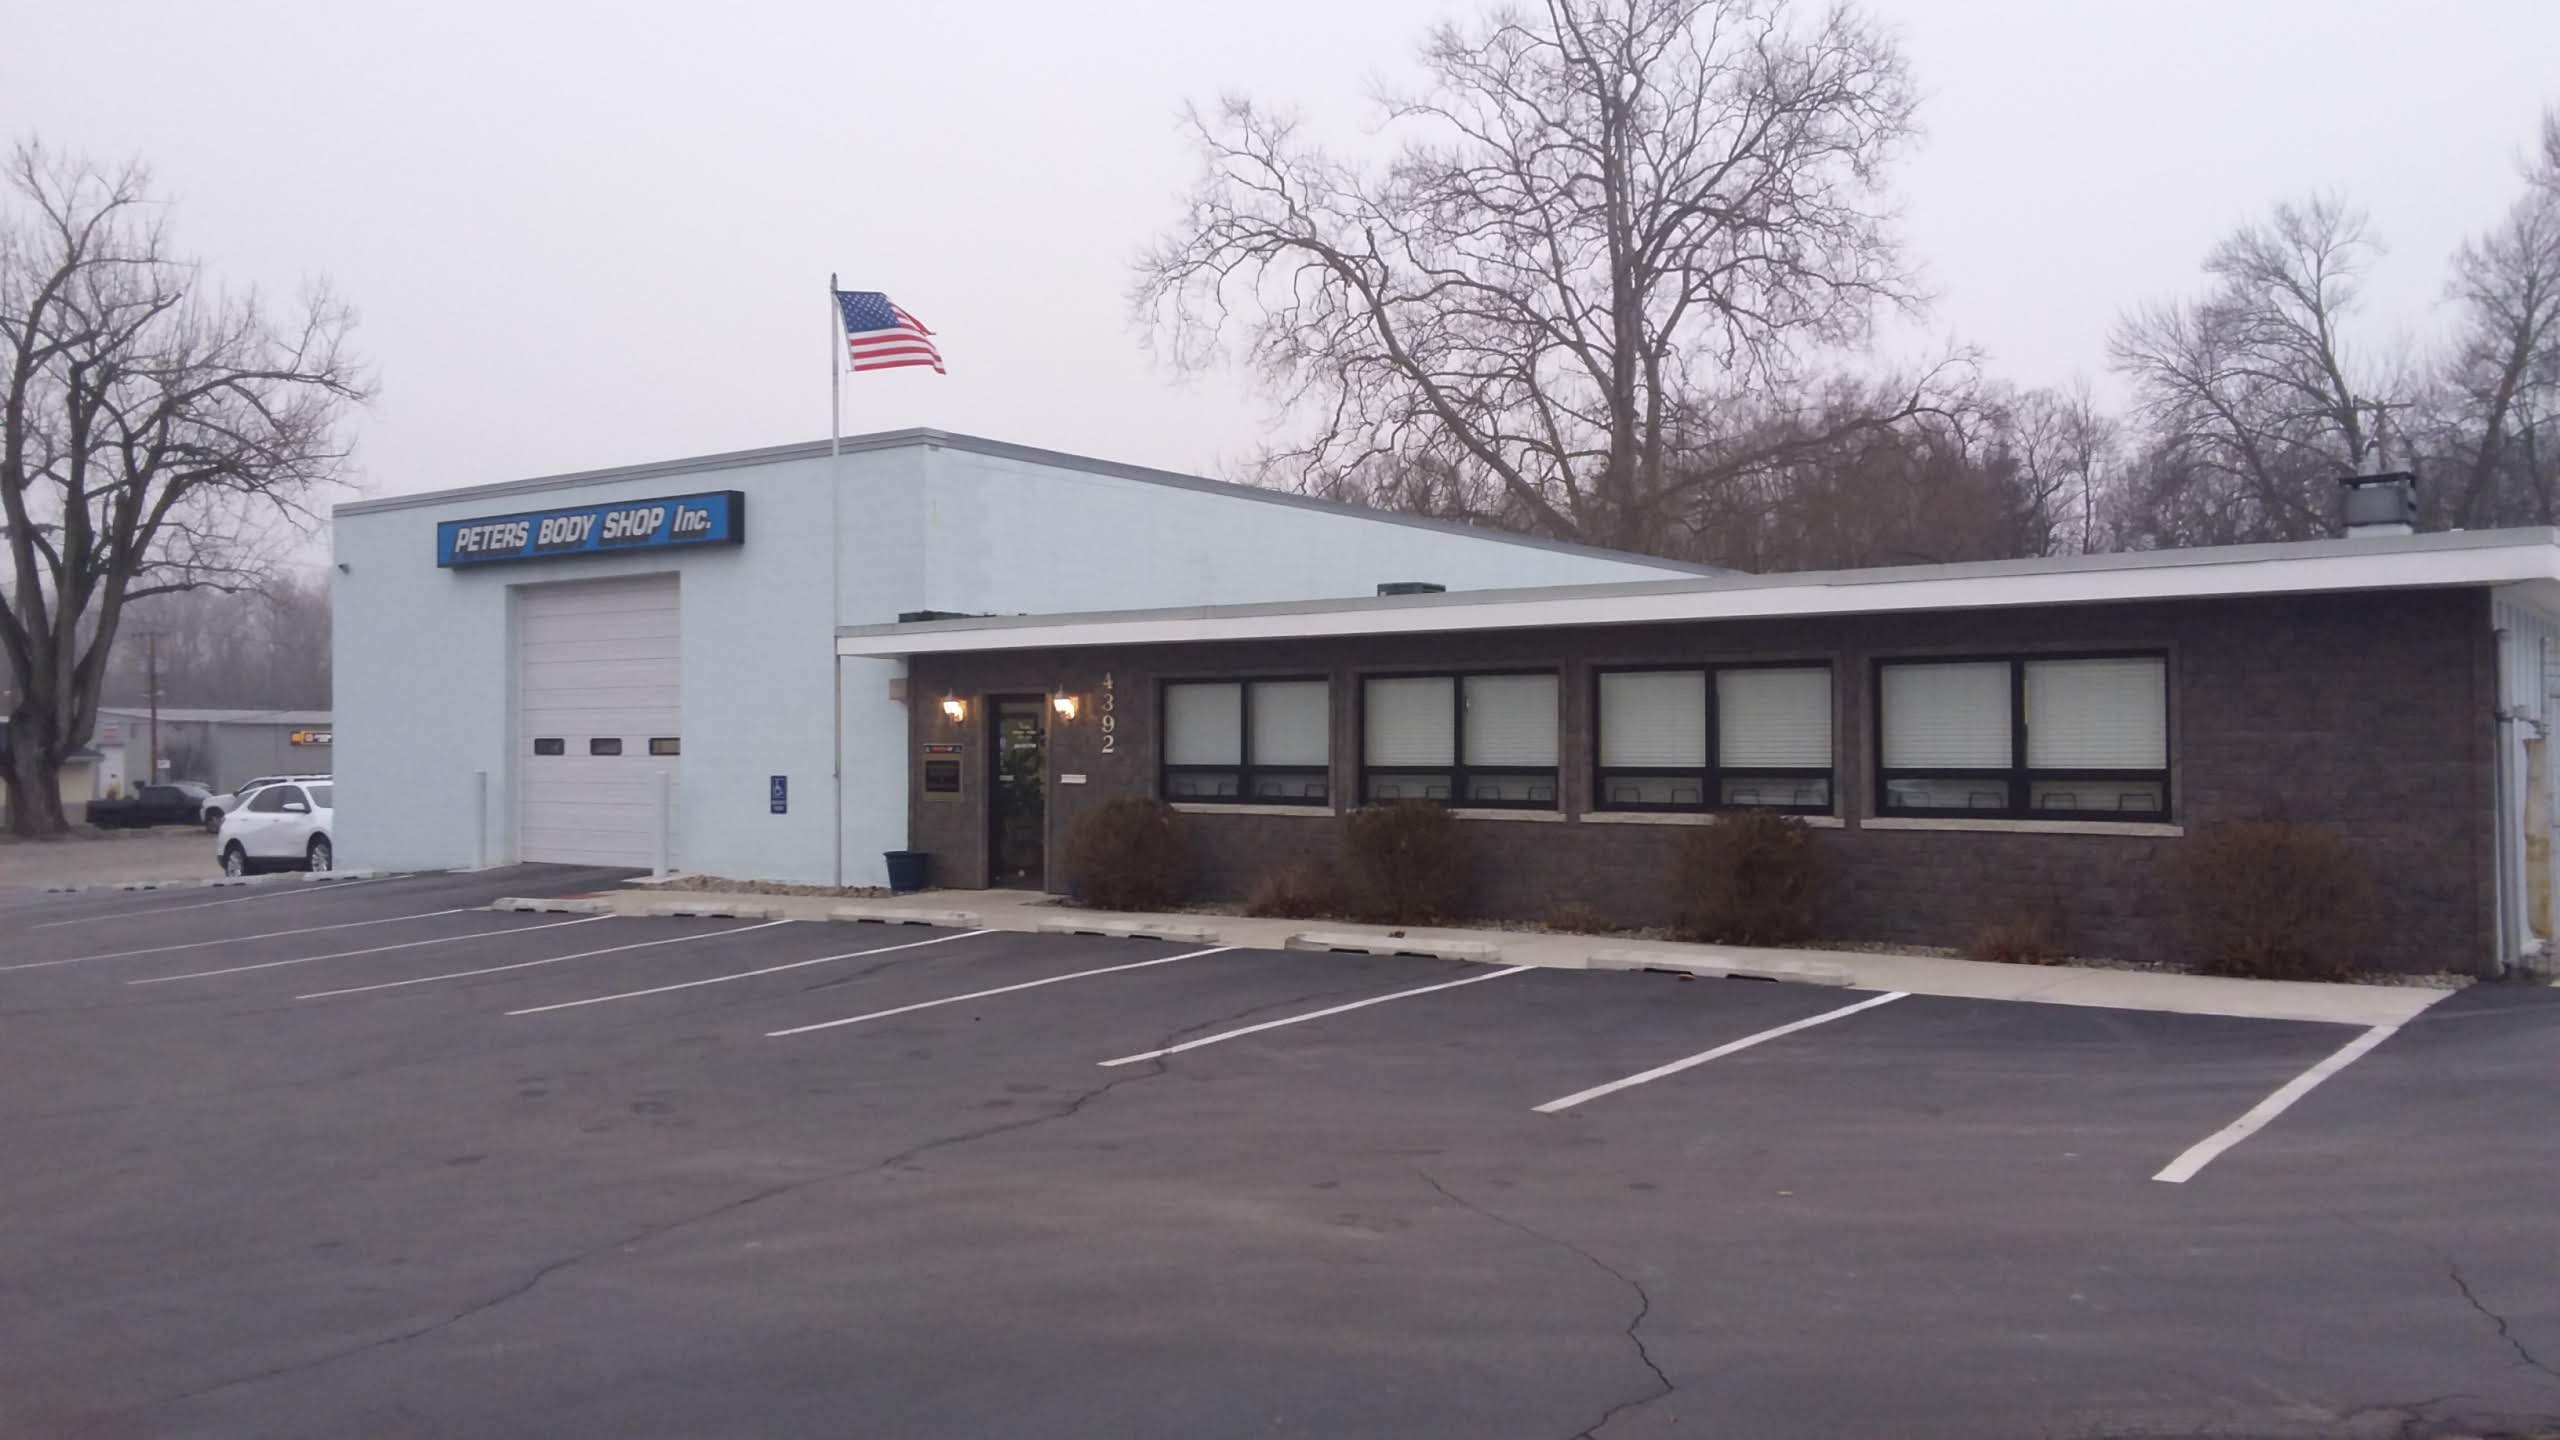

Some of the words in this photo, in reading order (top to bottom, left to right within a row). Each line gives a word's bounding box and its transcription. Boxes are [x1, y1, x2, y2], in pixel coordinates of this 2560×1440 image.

[455, 521, 530, 553] PETERS
[537, 514, 597, 545] BODY
[603, 506, 665, 539] SHOP
[673, 505, 712, 532] Inc.
[1102, 672, 1114, 753] 4392
